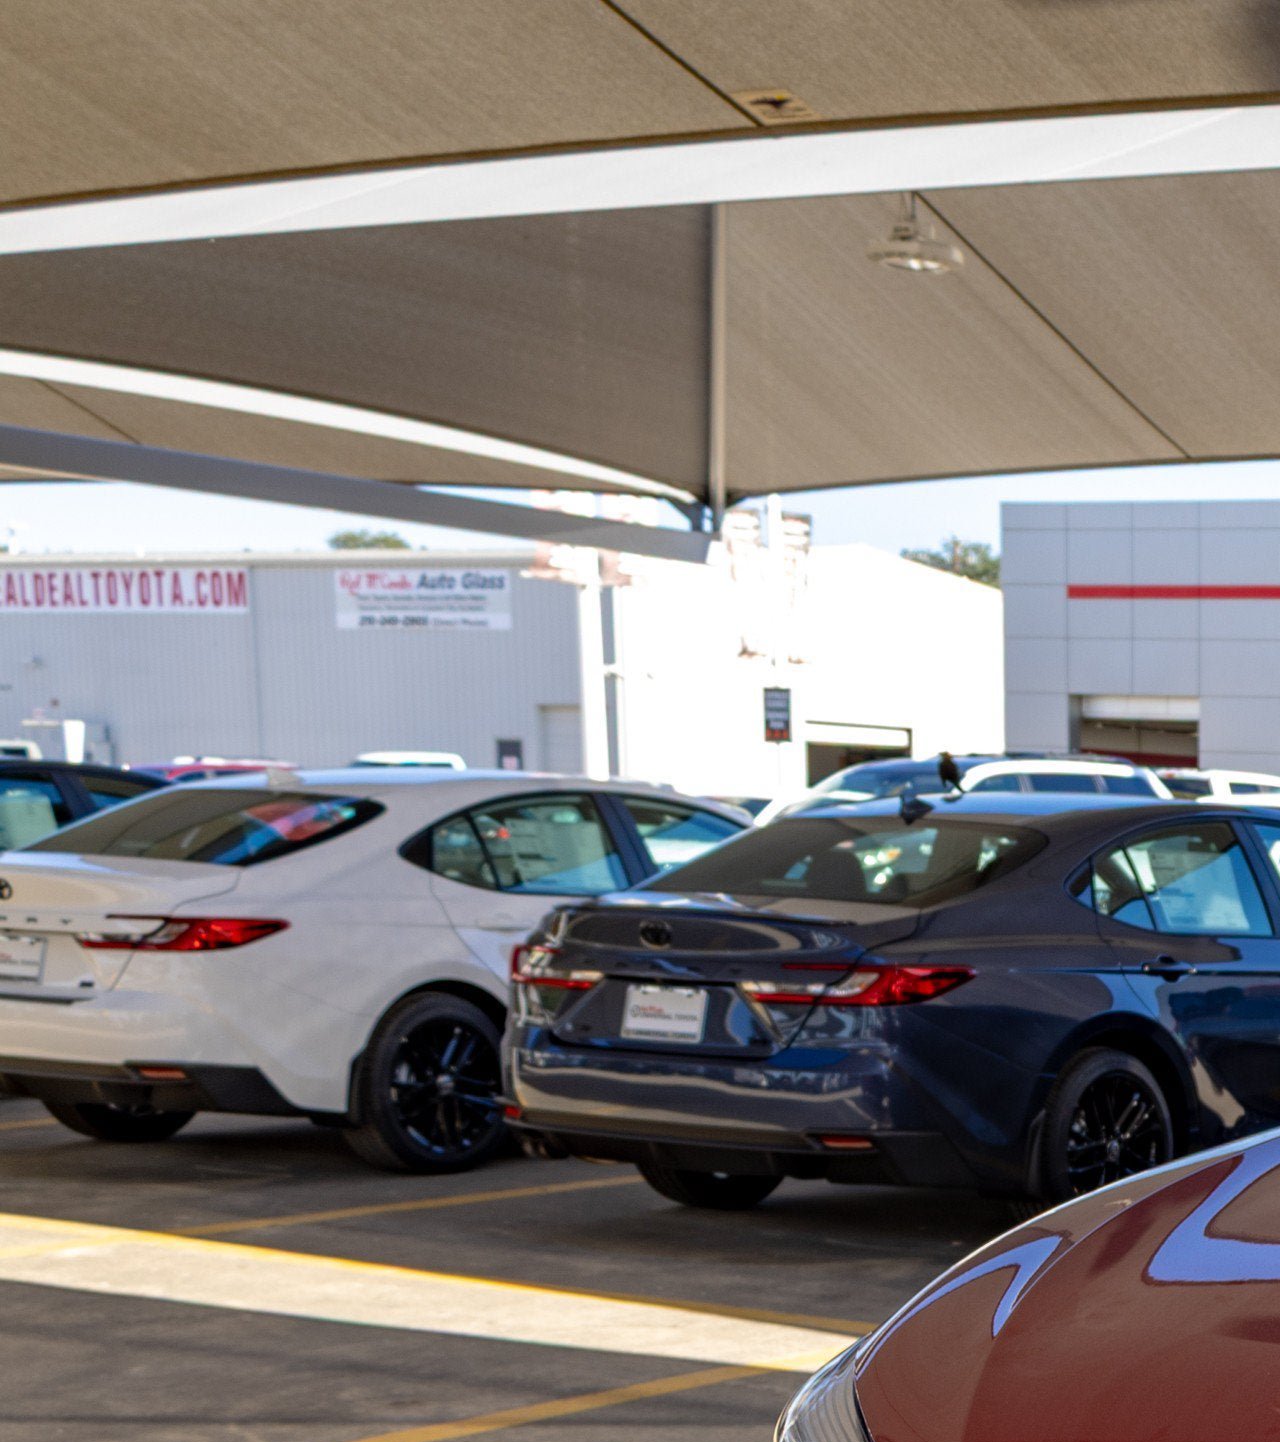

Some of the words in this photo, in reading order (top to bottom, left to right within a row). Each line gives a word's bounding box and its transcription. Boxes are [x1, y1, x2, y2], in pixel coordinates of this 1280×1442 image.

[0, 570, 248, 606] ALDEALTOYOTA.COM
[417, 572, 456, 590] Auto
[461, 572, 505, 590] Glass
